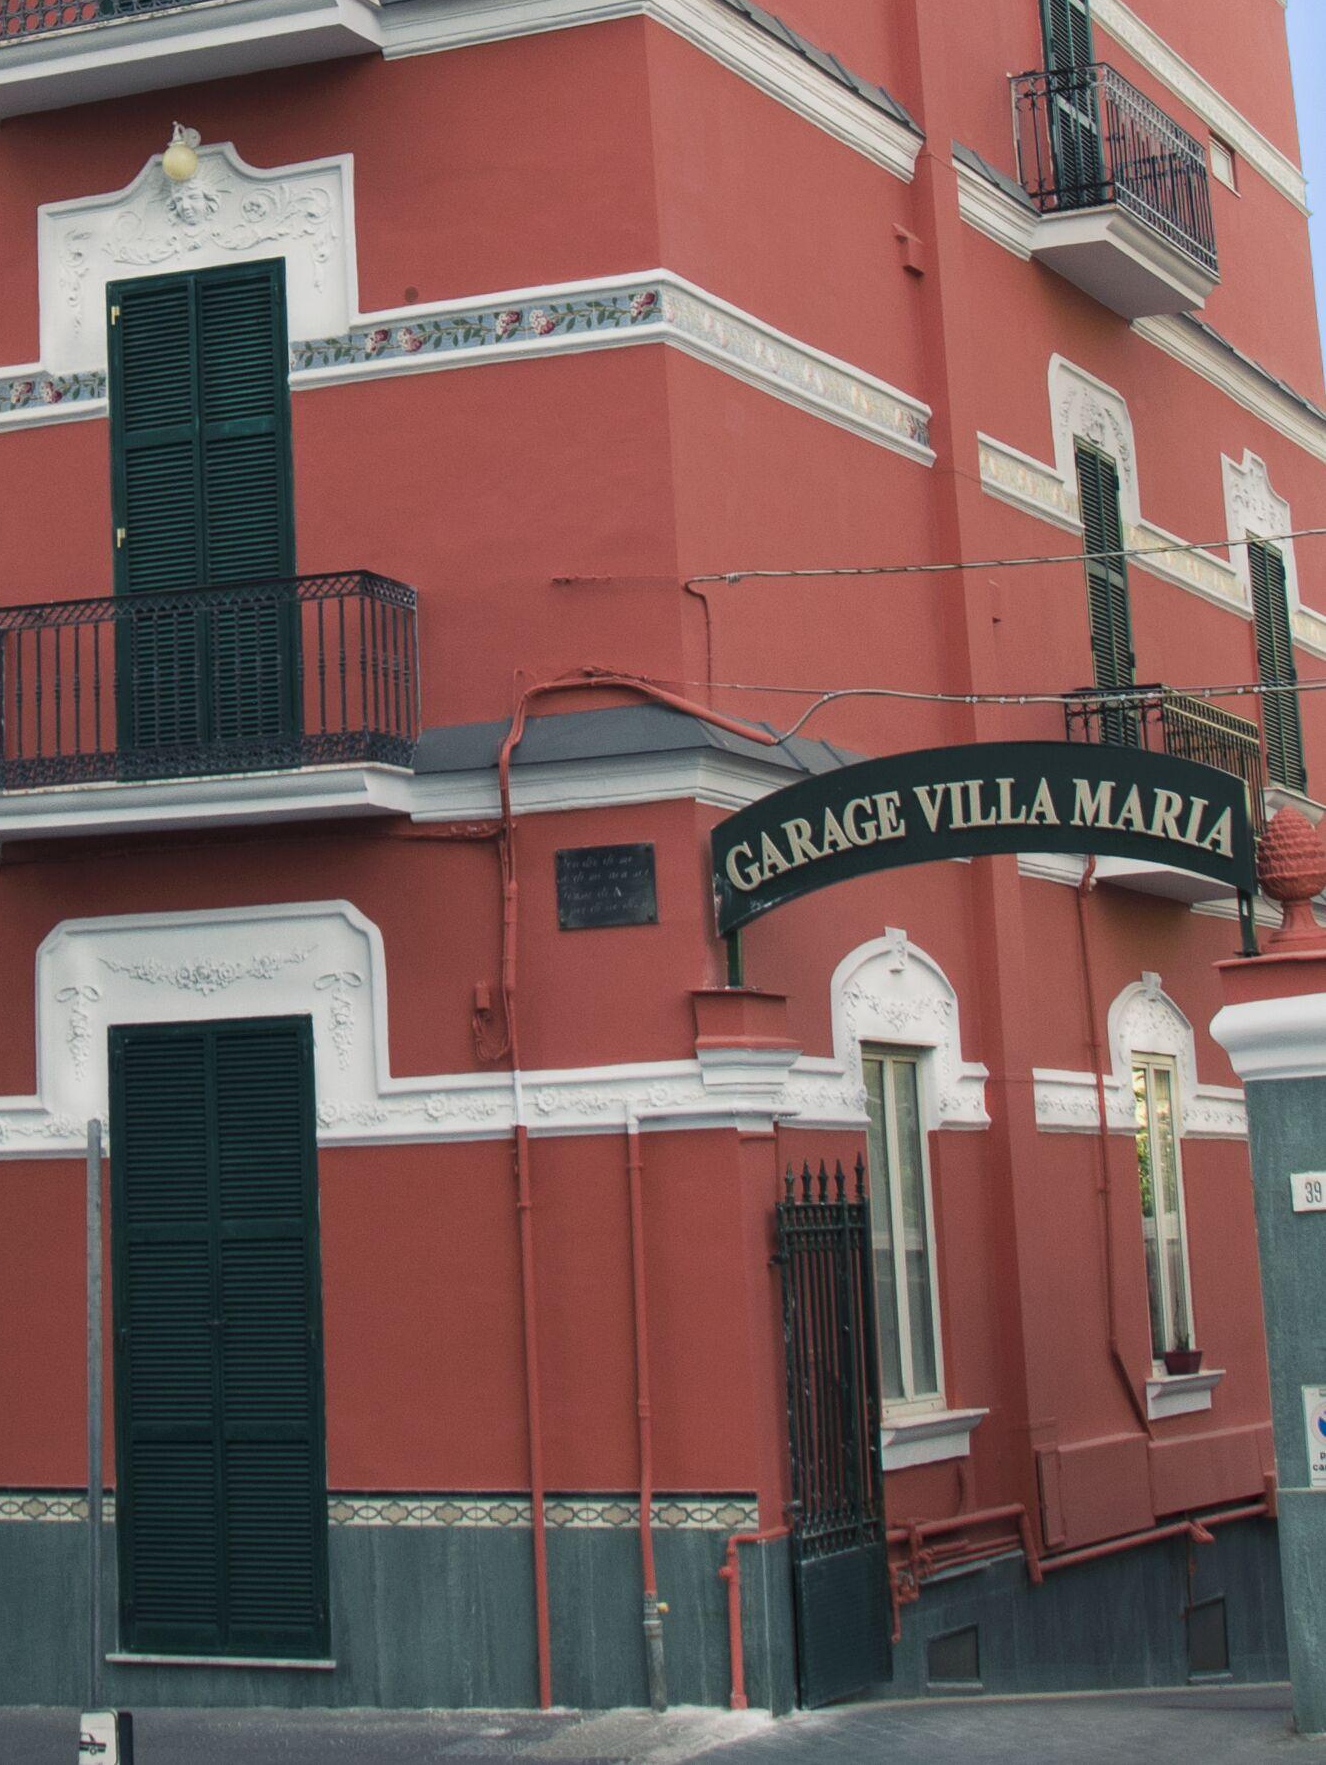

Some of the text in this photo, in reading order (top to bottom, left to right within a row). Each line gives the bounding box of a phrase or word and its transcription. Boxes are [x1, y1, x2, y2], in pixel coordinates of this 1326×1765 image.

[725, 777, 1235, 892] GARAGE VILLA MARIA
[1305, 1180, 1322, 1203] 39
